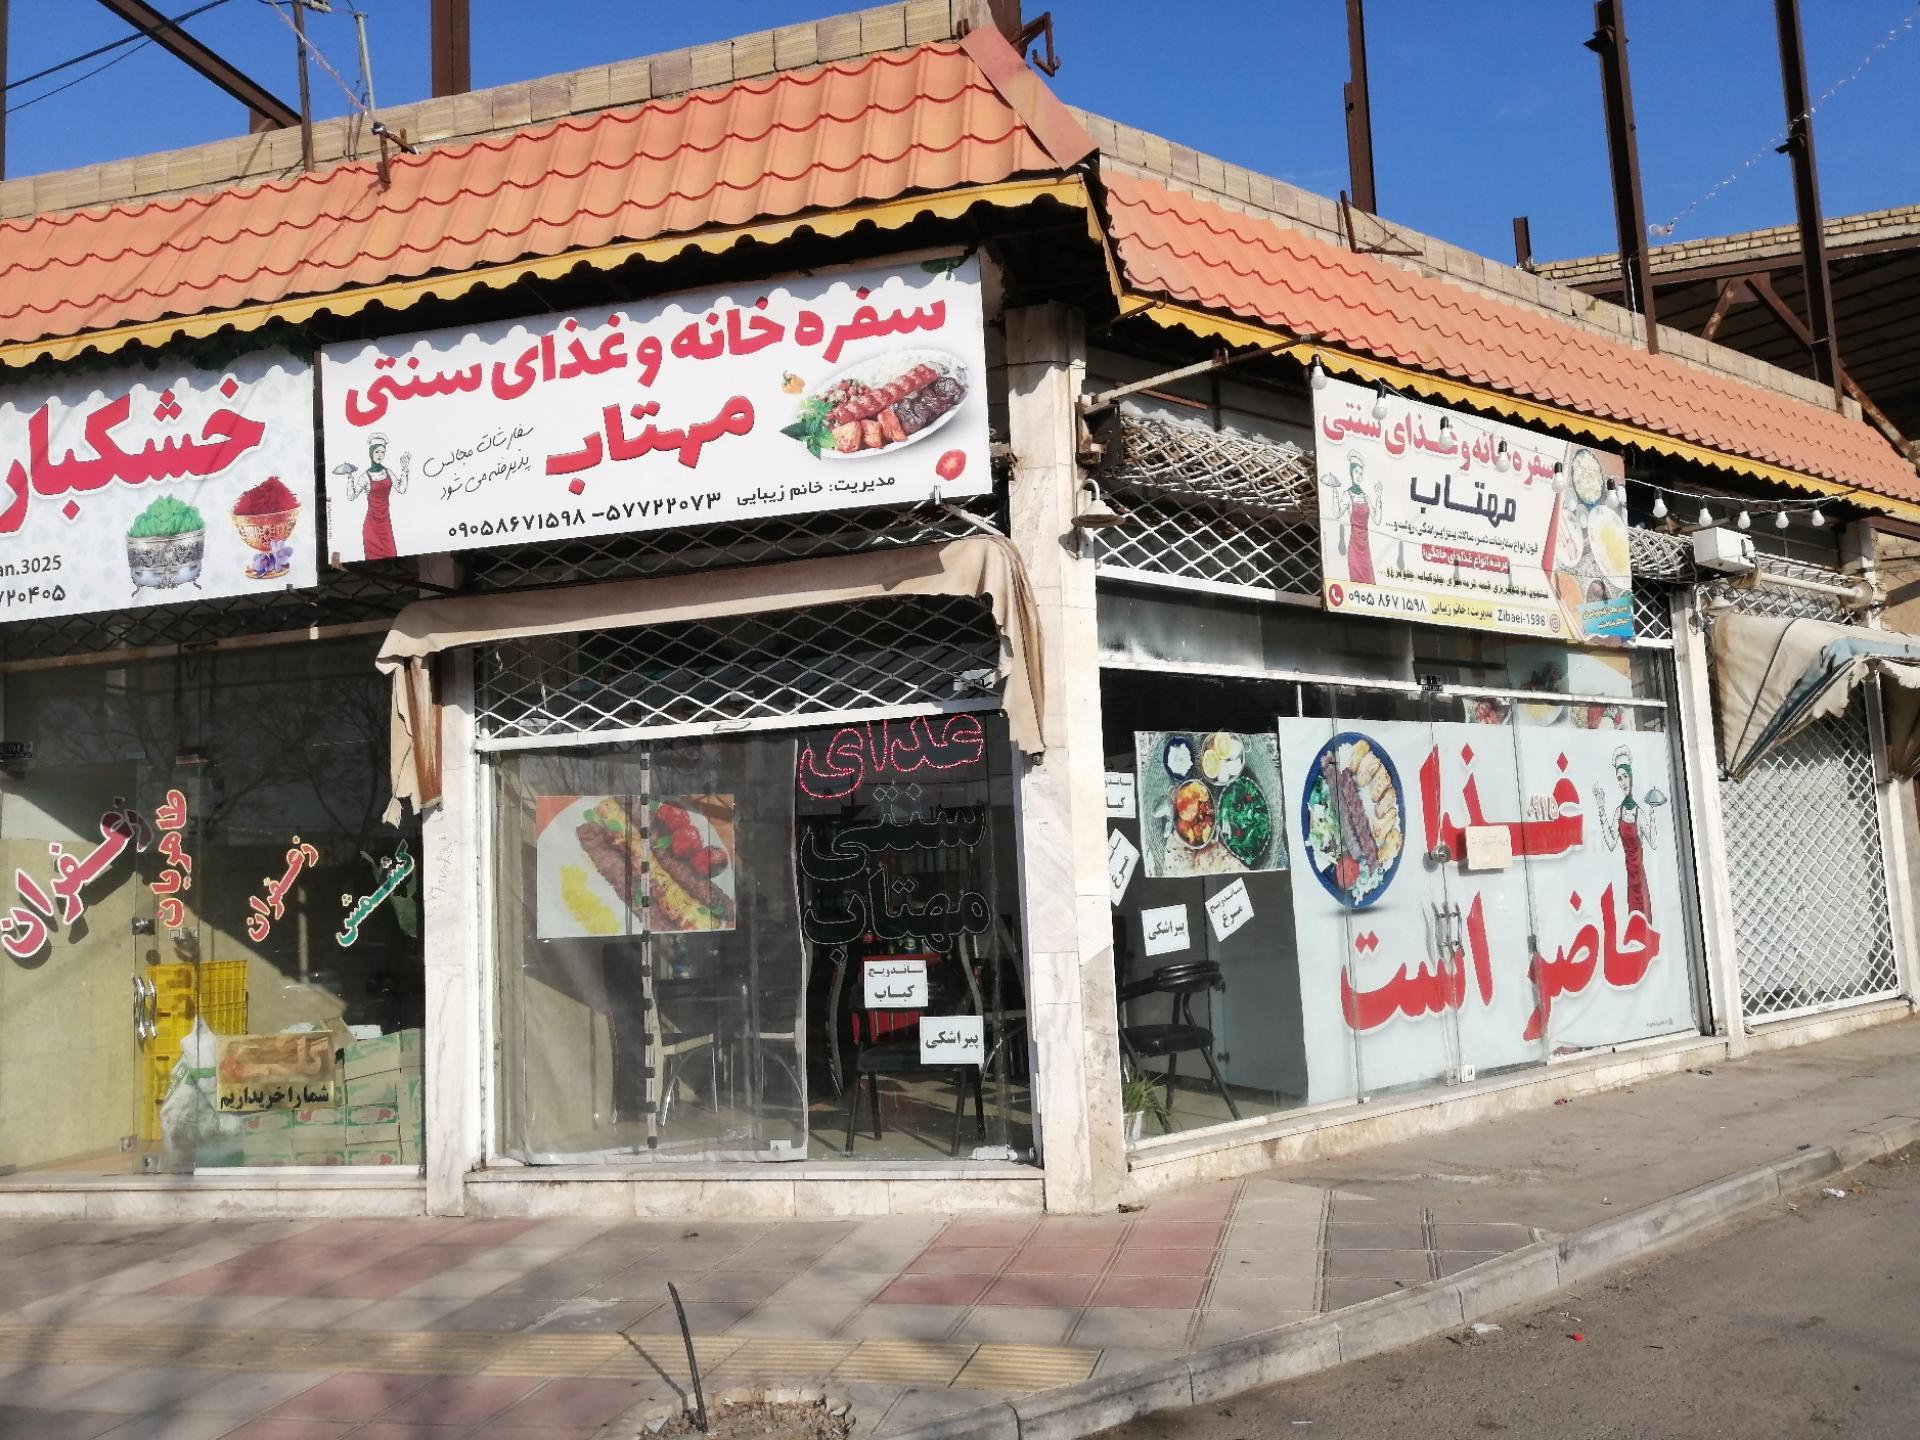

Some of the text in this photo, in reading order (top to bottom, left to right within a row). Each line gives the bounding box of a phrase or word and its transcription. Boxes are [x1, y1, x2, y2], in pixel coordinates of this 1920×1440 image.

[345, 286, 947, 427] سفره خانه و غذای سنتی
[545, 395, 755, 496] مهتاب
[1323, 402, 1382, 442] سنتی
[1473, 431, 1511, 466] انه
[423, 423, 534, 478] سفارشات مجالس
[440, 448, 531, 501] پذیرفته می شود
[736, 475, 896, 507] مدیریت: خانم زیبایی
[1410, 474, 1517, 529] مهتاب
[1106, 796, 1126, 813] کبا
[1419, 741, 1584, 863] غذا
[150, 789, 192, 928] طاهریان
[800, 782, 986, 882] سنتی
[0, 796, 154, 958] زعفران
[246, 835, 319, 942] زعفران
[803, 864, 992, 966] مهتاب
[1148, 919, 1186, 941] پیراشکی
[1340, 881, 1661, 1042] حاضر است
[874, 984, 915, 1002] کباب
[925, 1030, 979, 1049] پیراشکی
